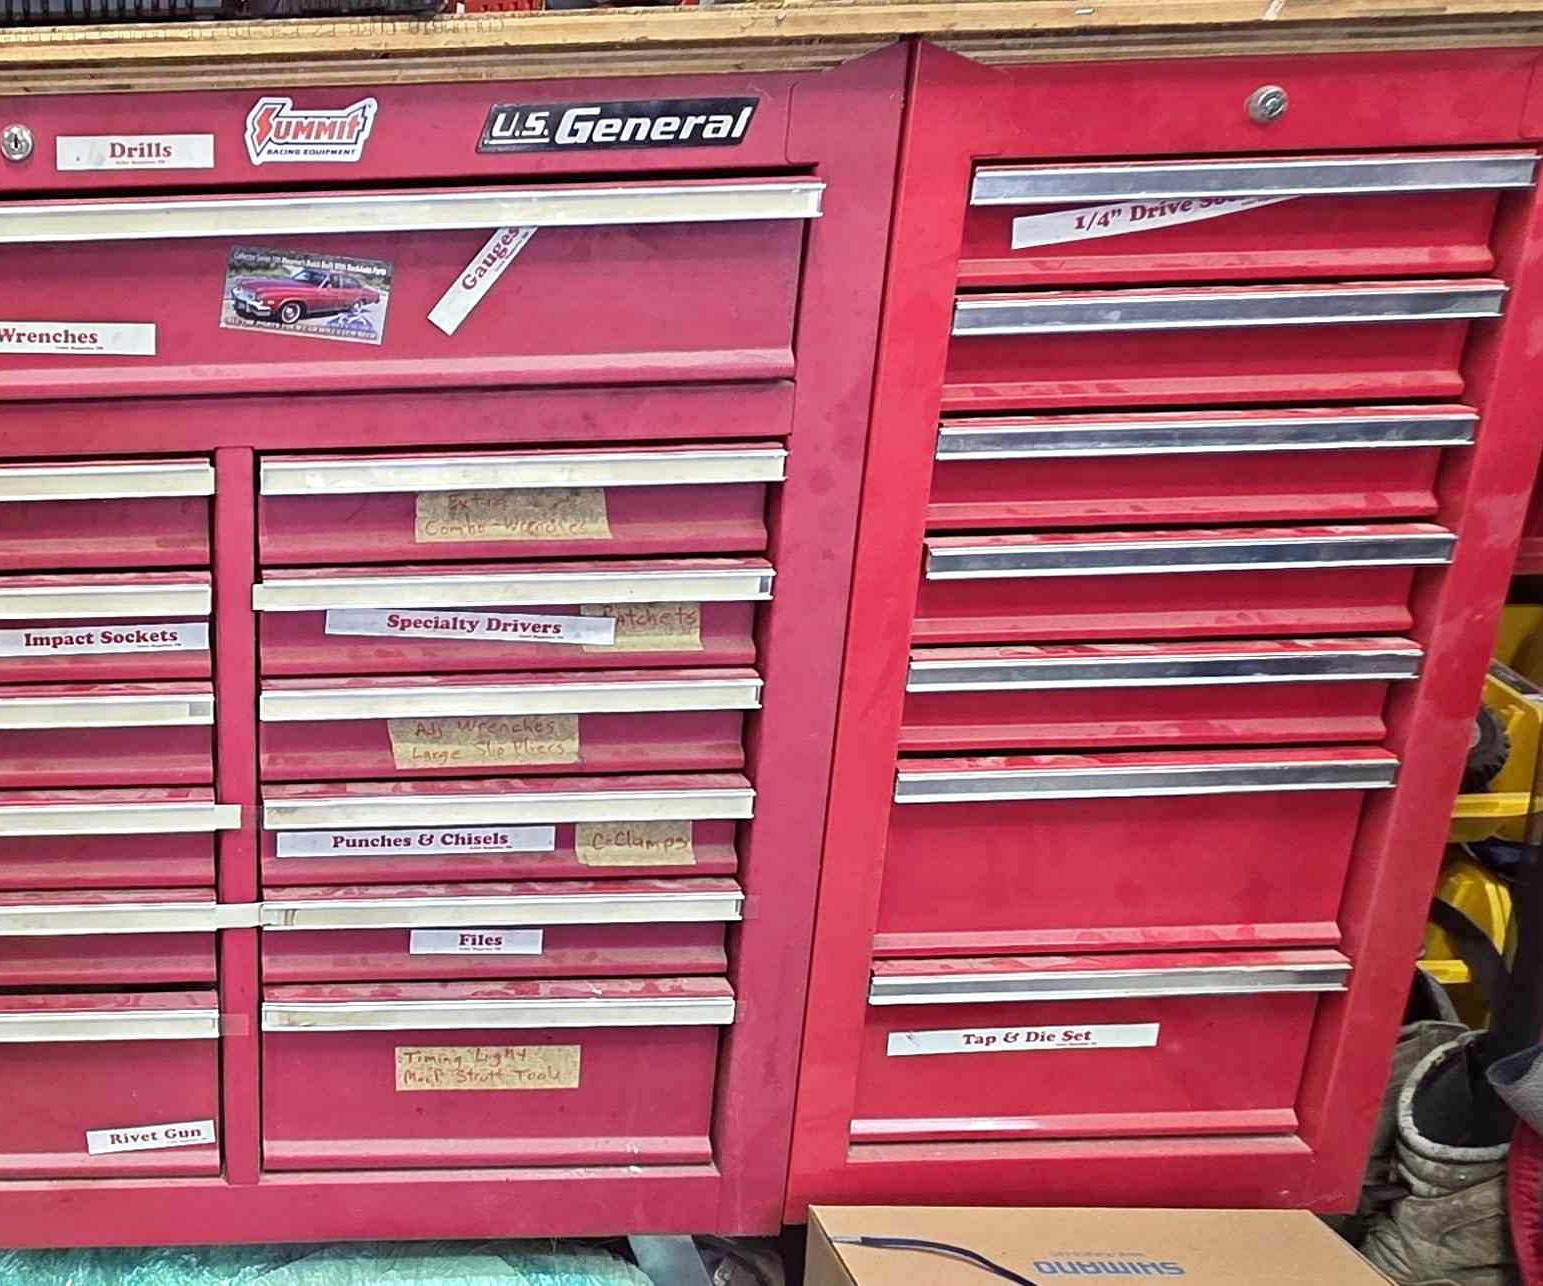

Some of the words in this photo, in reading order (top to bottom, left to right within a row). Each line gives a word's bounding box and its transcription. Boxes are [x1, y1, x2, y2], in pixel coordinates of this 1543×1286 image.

[491, 111, 550, 138] U.S.
[554, 106, 753, 144] General
[109, 142, 173, 158] Drills
[1129, 199, 1194, 222] Drive
[386, 612, 480, 634] Specialty
[484, 617, 562, 635] Drivers
[23, 632, 94, 650] Impact
[99, 628, 178, 645] Sockets
[458, 716, 556, 734] Wrenches
[412, 747, 461, 763] Large
[332, 833, 411, 848] Punches
[418, 832, 435, 846] &
[440, 831, 509, 846] Chisels
[459, 933, 504, 947] Files
[962, 1034, 997, 1047] Tap
[1003, 1032, 1021, 1043] &
[1025, 1031, 1057, 1043] Die
[1061, 1030, 1093, 1042] Set
[110, 1132, 159, 1145] Rivet
[164, 1128, 202, 1140] Gun
[1033, 1261, 1185, 1275] SHIMANO
